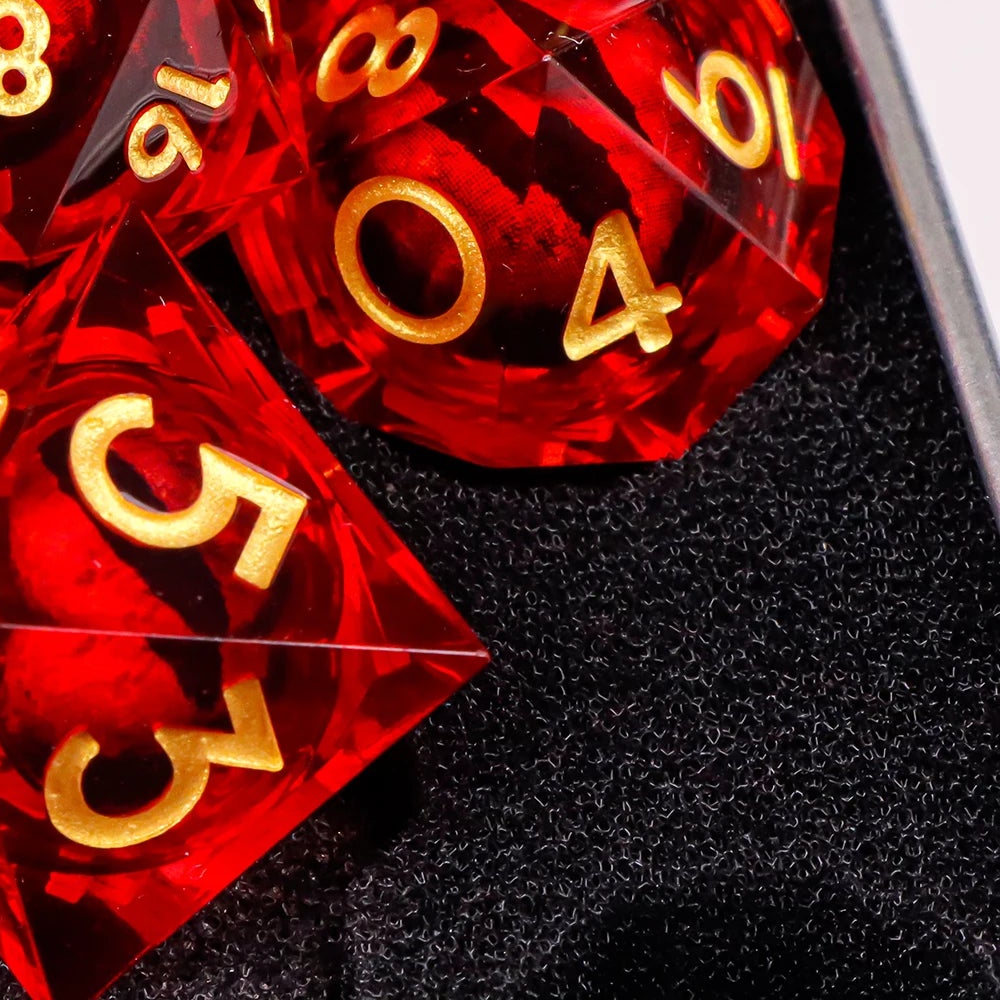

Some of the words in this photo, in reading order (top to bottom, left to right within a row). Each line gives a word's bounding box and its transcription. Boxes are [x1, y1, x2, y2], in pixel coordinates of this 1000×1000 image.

[315, 4, 438, 102] 8
[69, 392, 308, 590] 5
[44, 678, 285, 849] 3
